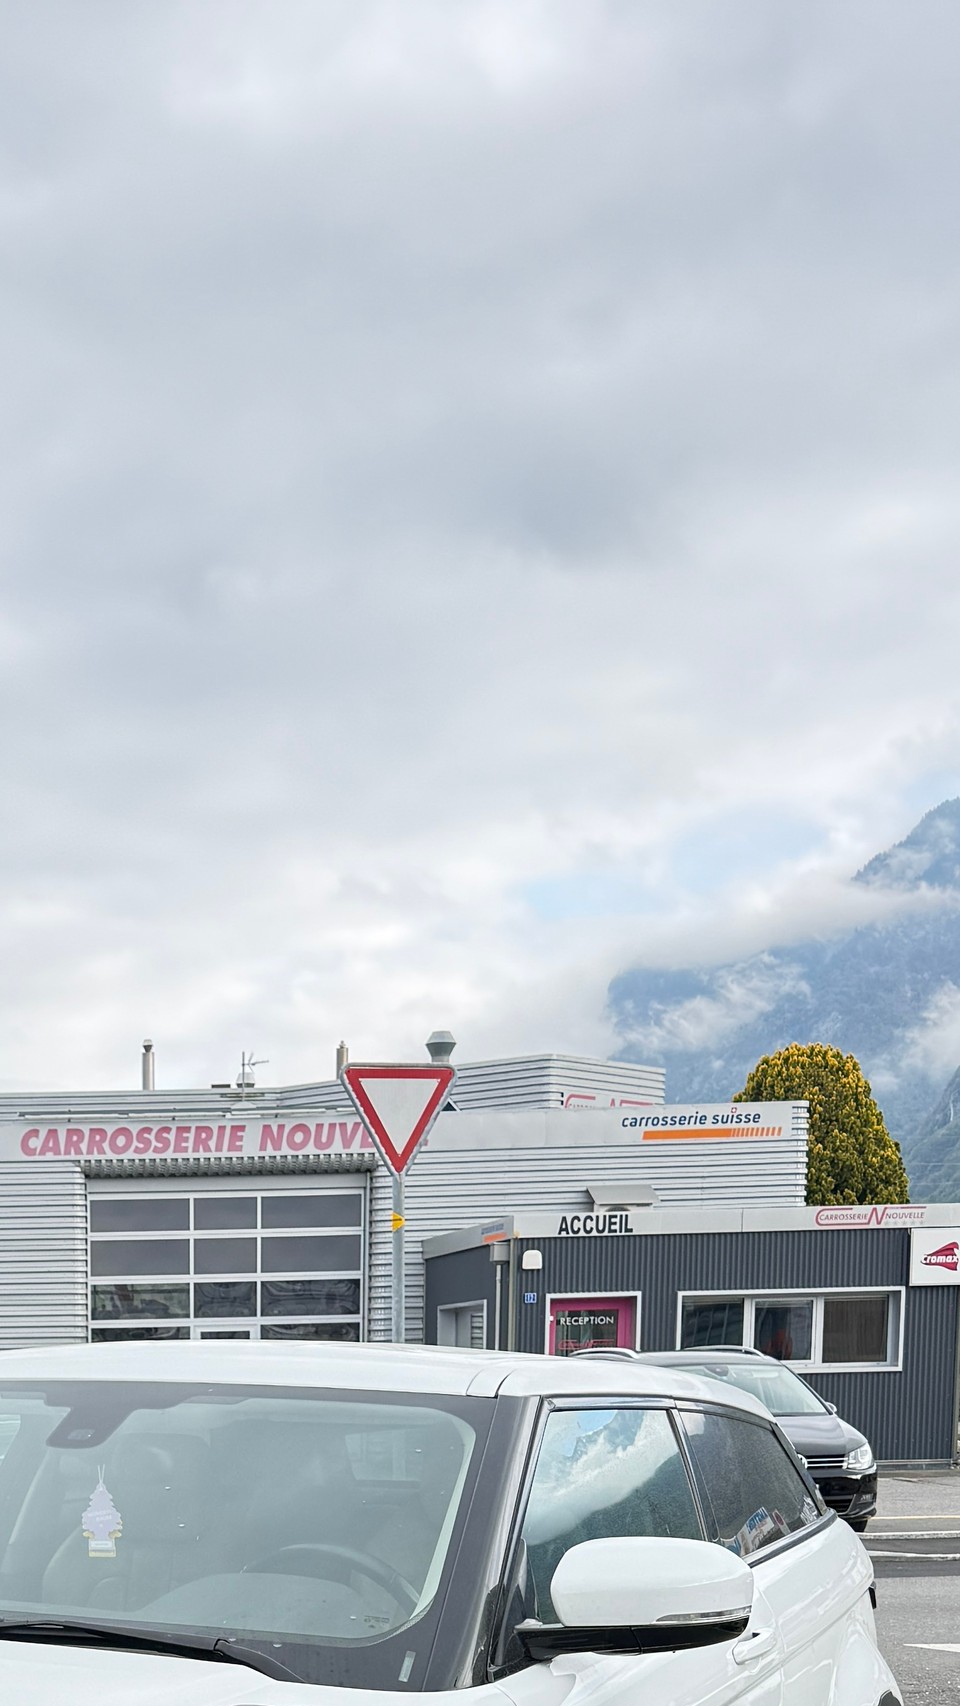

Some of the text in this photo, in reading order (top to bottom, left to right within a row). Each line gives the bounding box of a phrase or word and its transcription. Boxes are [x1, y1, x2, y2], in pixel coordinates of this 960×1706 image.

[621, 1107, 761, 1127] carrosserie suisse
[20, 1124, 247, 1157] CARROSSERIE
[558, 1214, 634, 1236] ACCUEIL
[560, 1316, 614, 1325] RECEPTION
